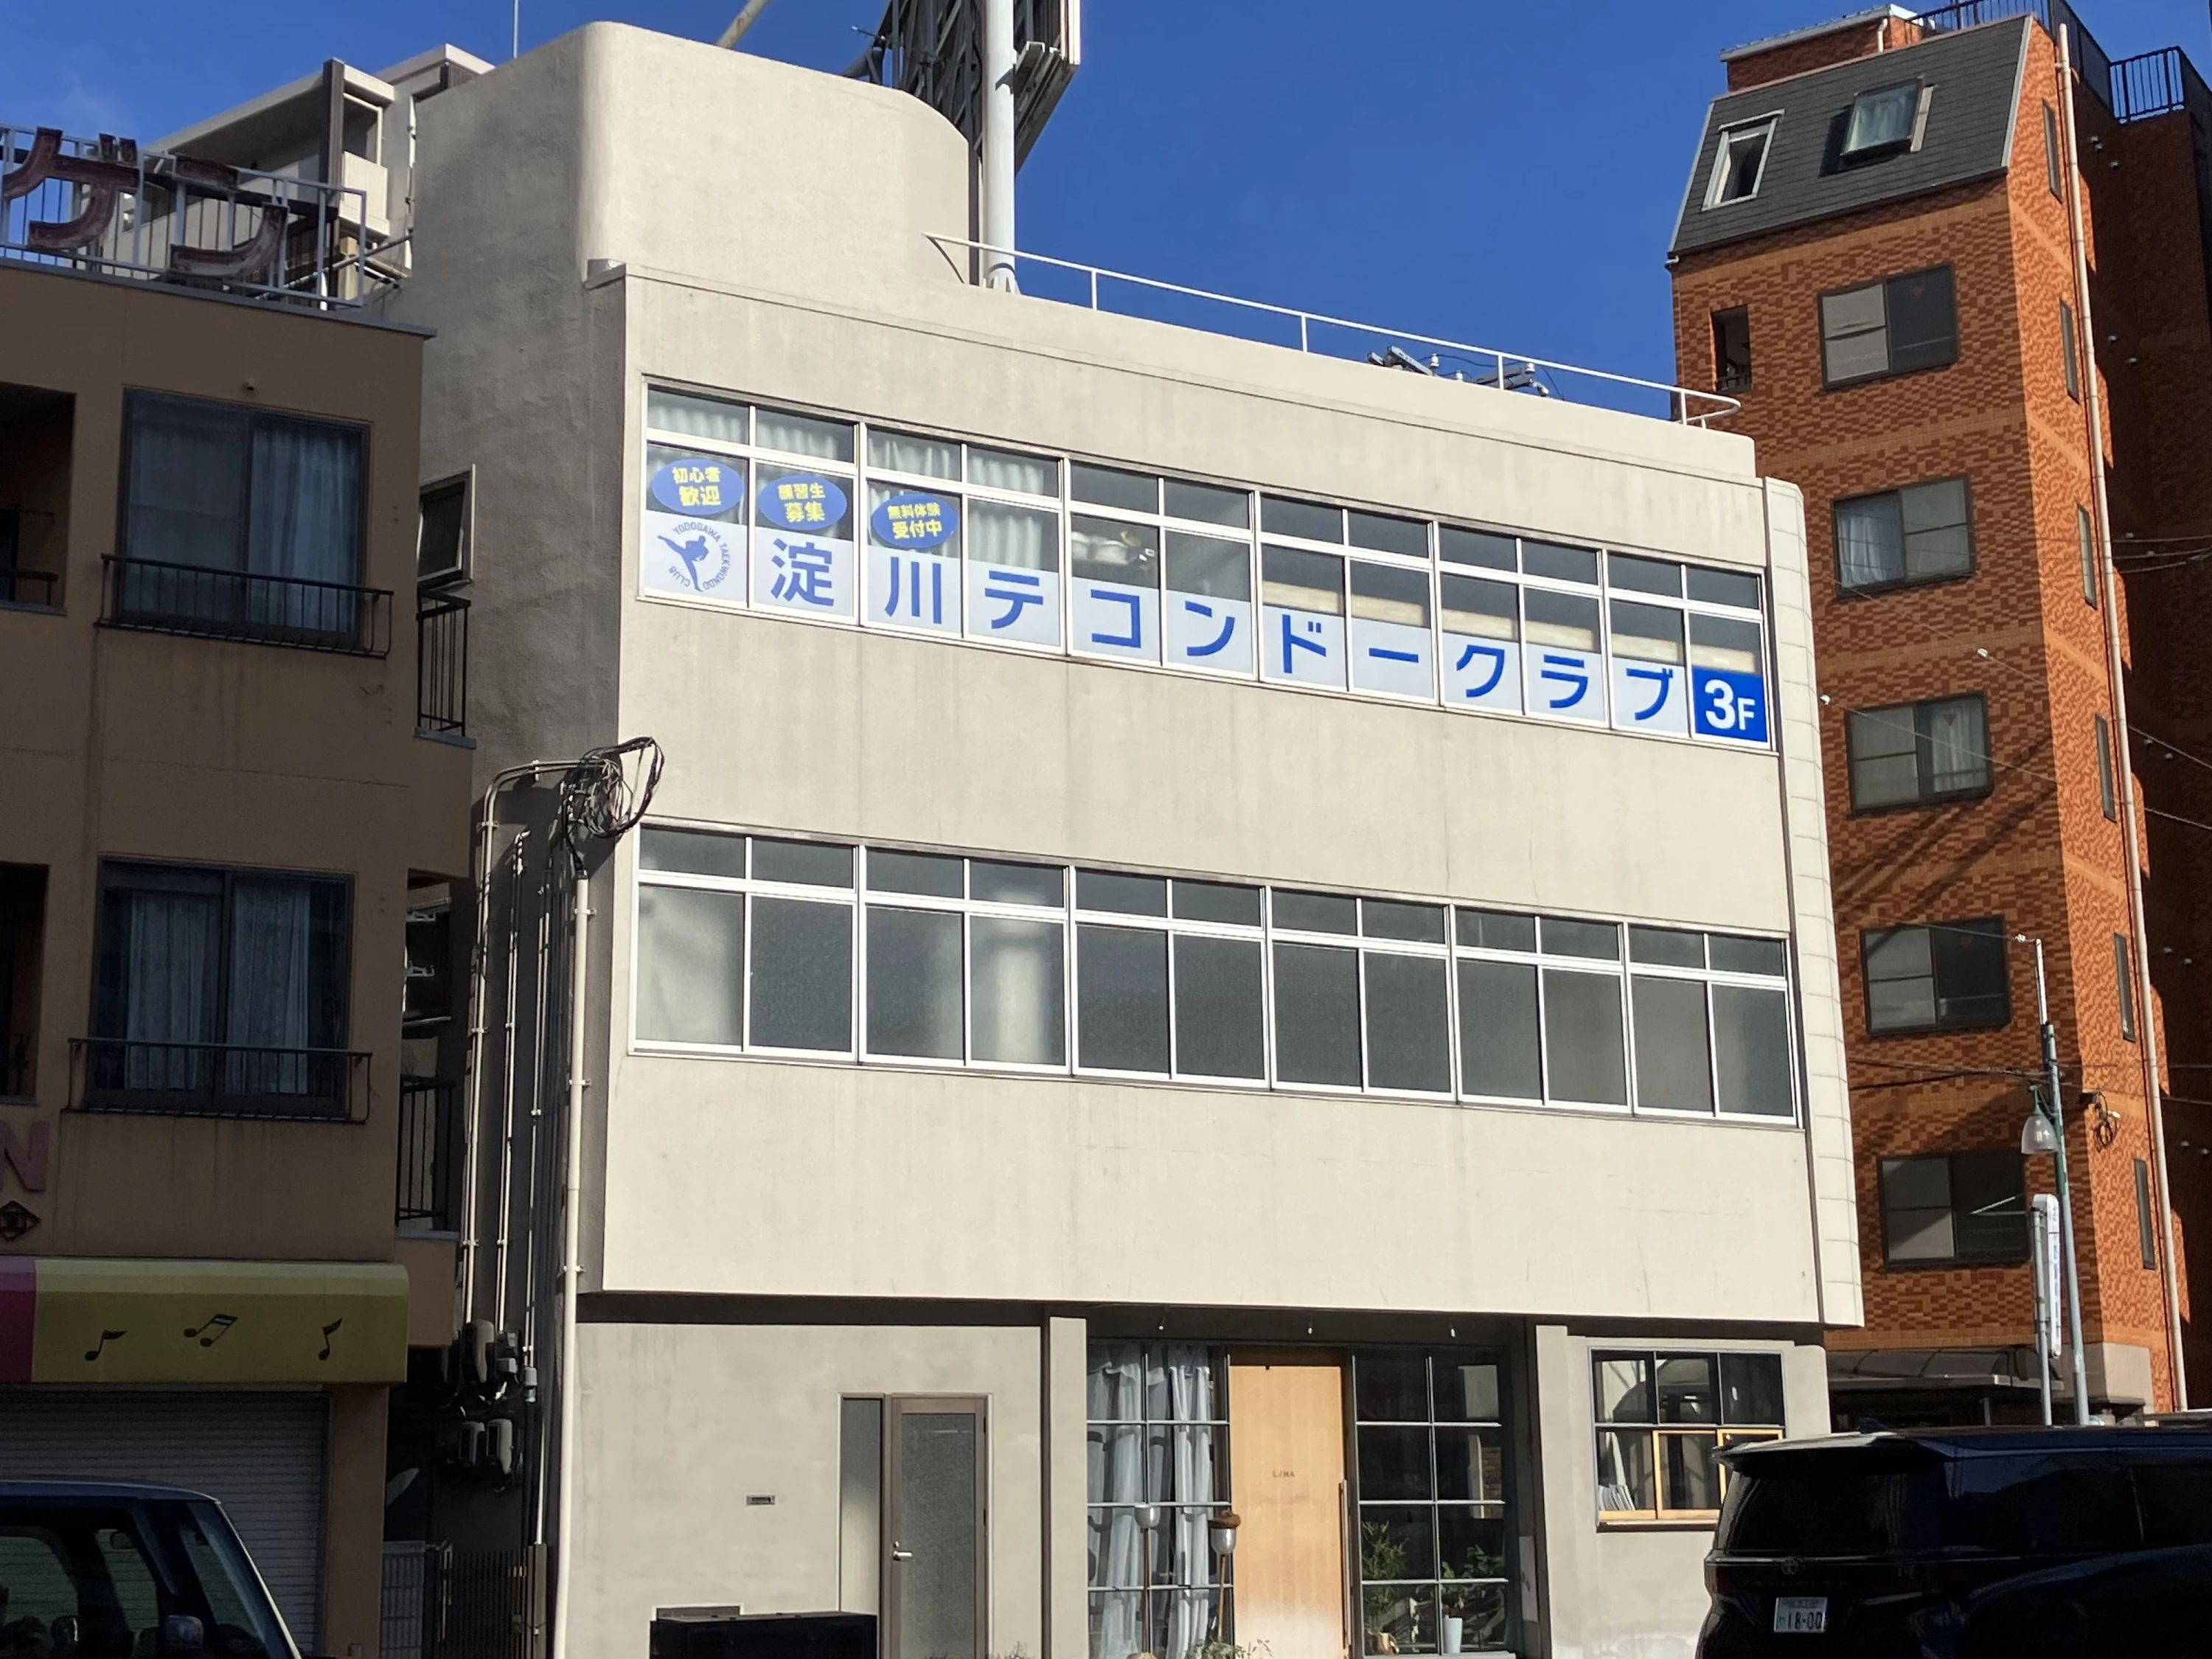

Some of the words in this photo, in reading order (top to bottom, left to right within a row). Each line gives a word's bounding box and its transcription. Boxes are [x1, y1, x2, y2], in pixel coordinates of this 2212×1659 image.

[672, 466, 721, 484] 初心者
[678, 485, 722, 507] 歓迎
[785, 501, 826, 523] 募集
[887, 501, 941, 520] 無料体験
[672, 521, 722, 543] YODOGAWA
[891, 518, 942, 539] 受付中
[669, 566, 692, 588] CLUB
[702, 542, 731, 591] TAEKWONDO
[771, 538, 1674, 721] 淀川テコンドークラブ
[1703, 679, 1756, 731] 3F
